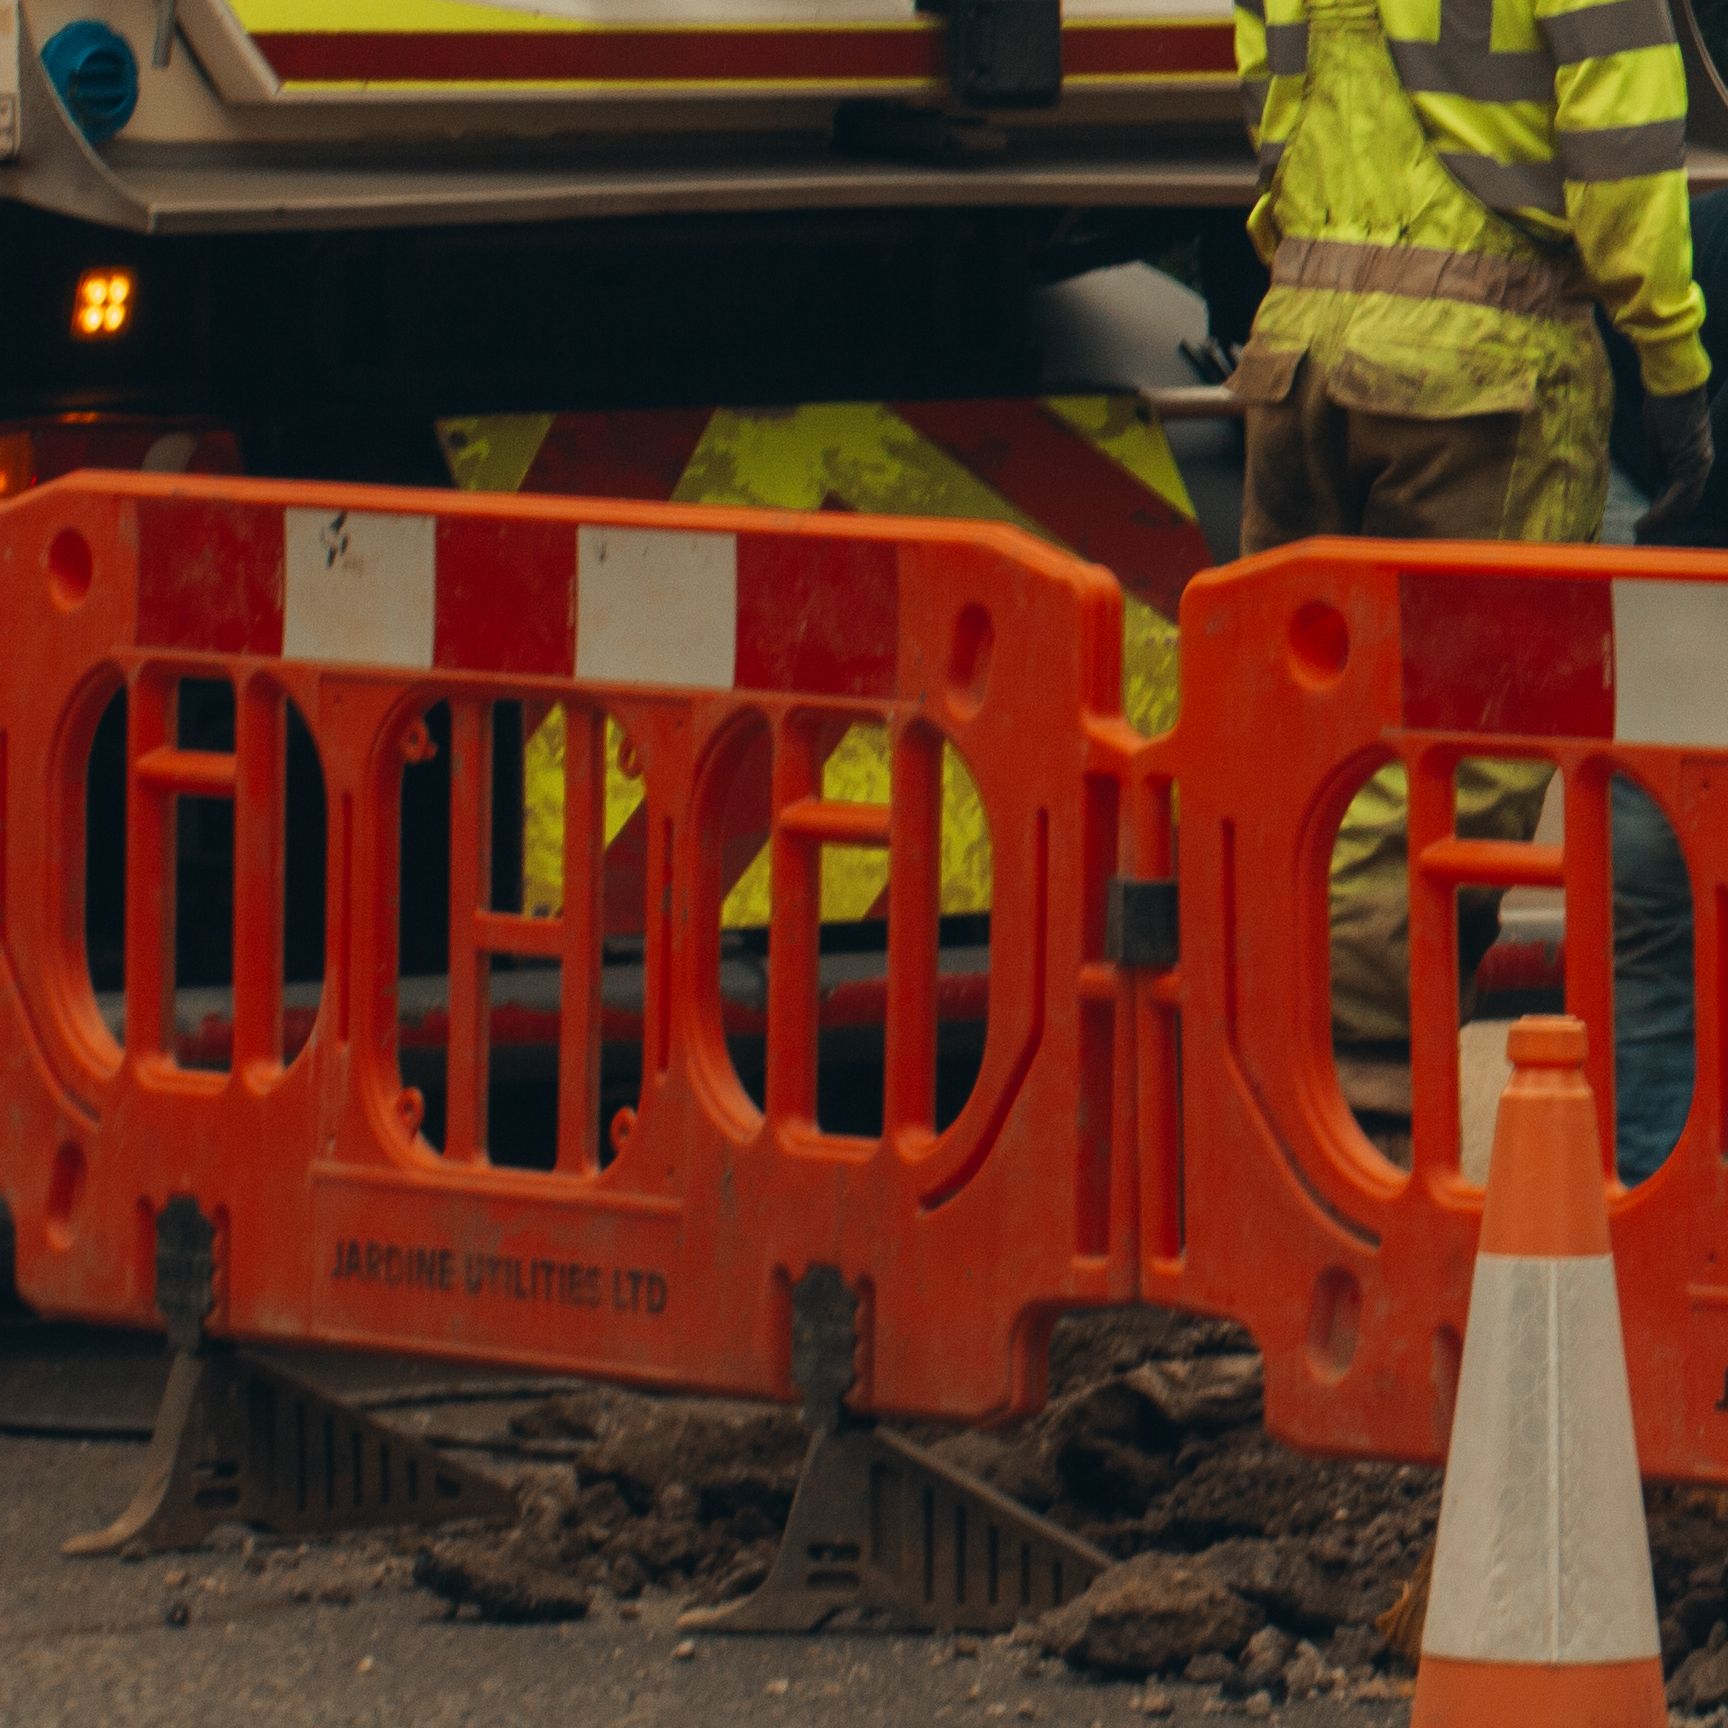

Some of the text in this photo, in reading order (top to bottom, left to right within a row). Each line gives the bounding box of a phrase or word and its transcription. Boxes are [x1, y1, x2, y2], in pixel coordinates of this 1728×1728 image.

[333, 1238, 669, 1316] JARDINE UTILITIES LTD
